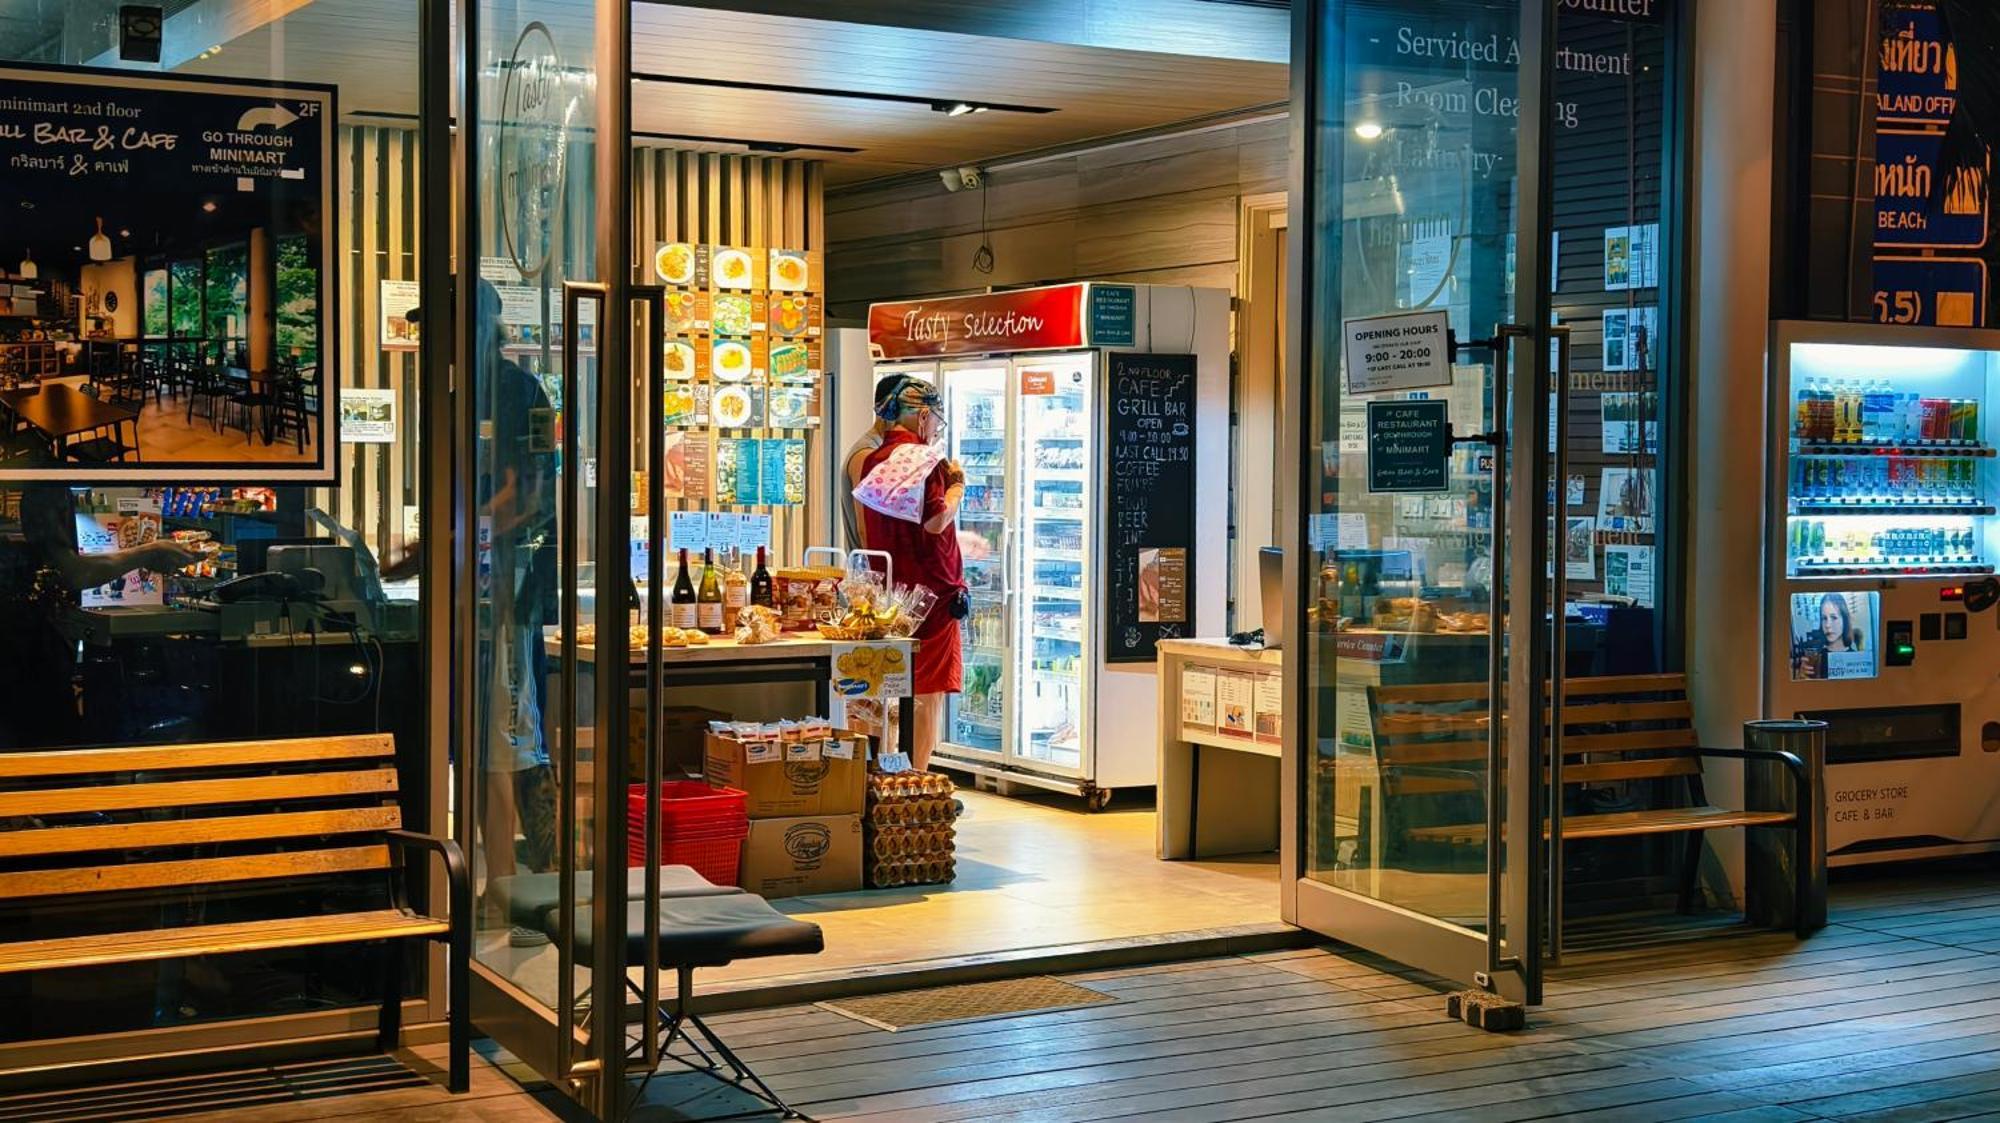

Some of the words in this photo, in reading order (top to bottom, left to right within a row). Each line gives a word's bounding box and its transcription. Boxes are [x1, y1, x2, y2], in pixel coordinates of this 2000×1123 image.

[1556, 0, 1652, 16] ounter
[1396, 27, 1498, 61] Serviced
[1504, 38, 1632, 76] Artment
[1396, 81, 1467, 112] Room
[106, 103, 142, 118] floor
[299, 102, 320, 118] 2F
[34, 122, 94, 145] BAR
[93, 125, 116, 151] &
[121, 127, 179, 151] CAFE
[202, 131, 224, 143] GO
[225, 132, 294, 148] THROUGH
[210, 147, 287, 164] MINIMART
[69, 153, 89, 176] &
[1875, 154, 1932, 199] หนัก
[1878, 210, 1928, 230] BEACH
[903, 305, 951, 352] Tasty
[963, 311, 1044, 340] Selection
[1354, 327, 1400, 341] OPENING
[1402, 324, 1438, 337] HOURS
[1364, 351, 1389, 363] 9:00
[1399, 347, 1431, 360] 20:00
[1117, 377, 1161, 397] CAFE
[1117, 399, 1161, 416] GRILL
[1164, 401, 1187, 417] BAR
[1395, 409, 1420, 418] CAFE
[1137, 418, 1163, 430] OPEN
[1377, 419, 1438, 429] RESTAURANT
[1115, 445, 1140, 459] LAST
[1142, 445, 1167, 462] CALL
[1385, 444, 1430, 455] MINIMART
[1115, 460, 1161, 477] COFFEE
[1480, 457, 1494, 470] PUS
[1834, 789, 1877, 802] GROCERY
[1879, 786, 1909, 800] STORE
[1834, 809, 1859, 822] CAFE
[1863, 808, 1870, 820] &
[1874, 806, 1895, 819] BAR
